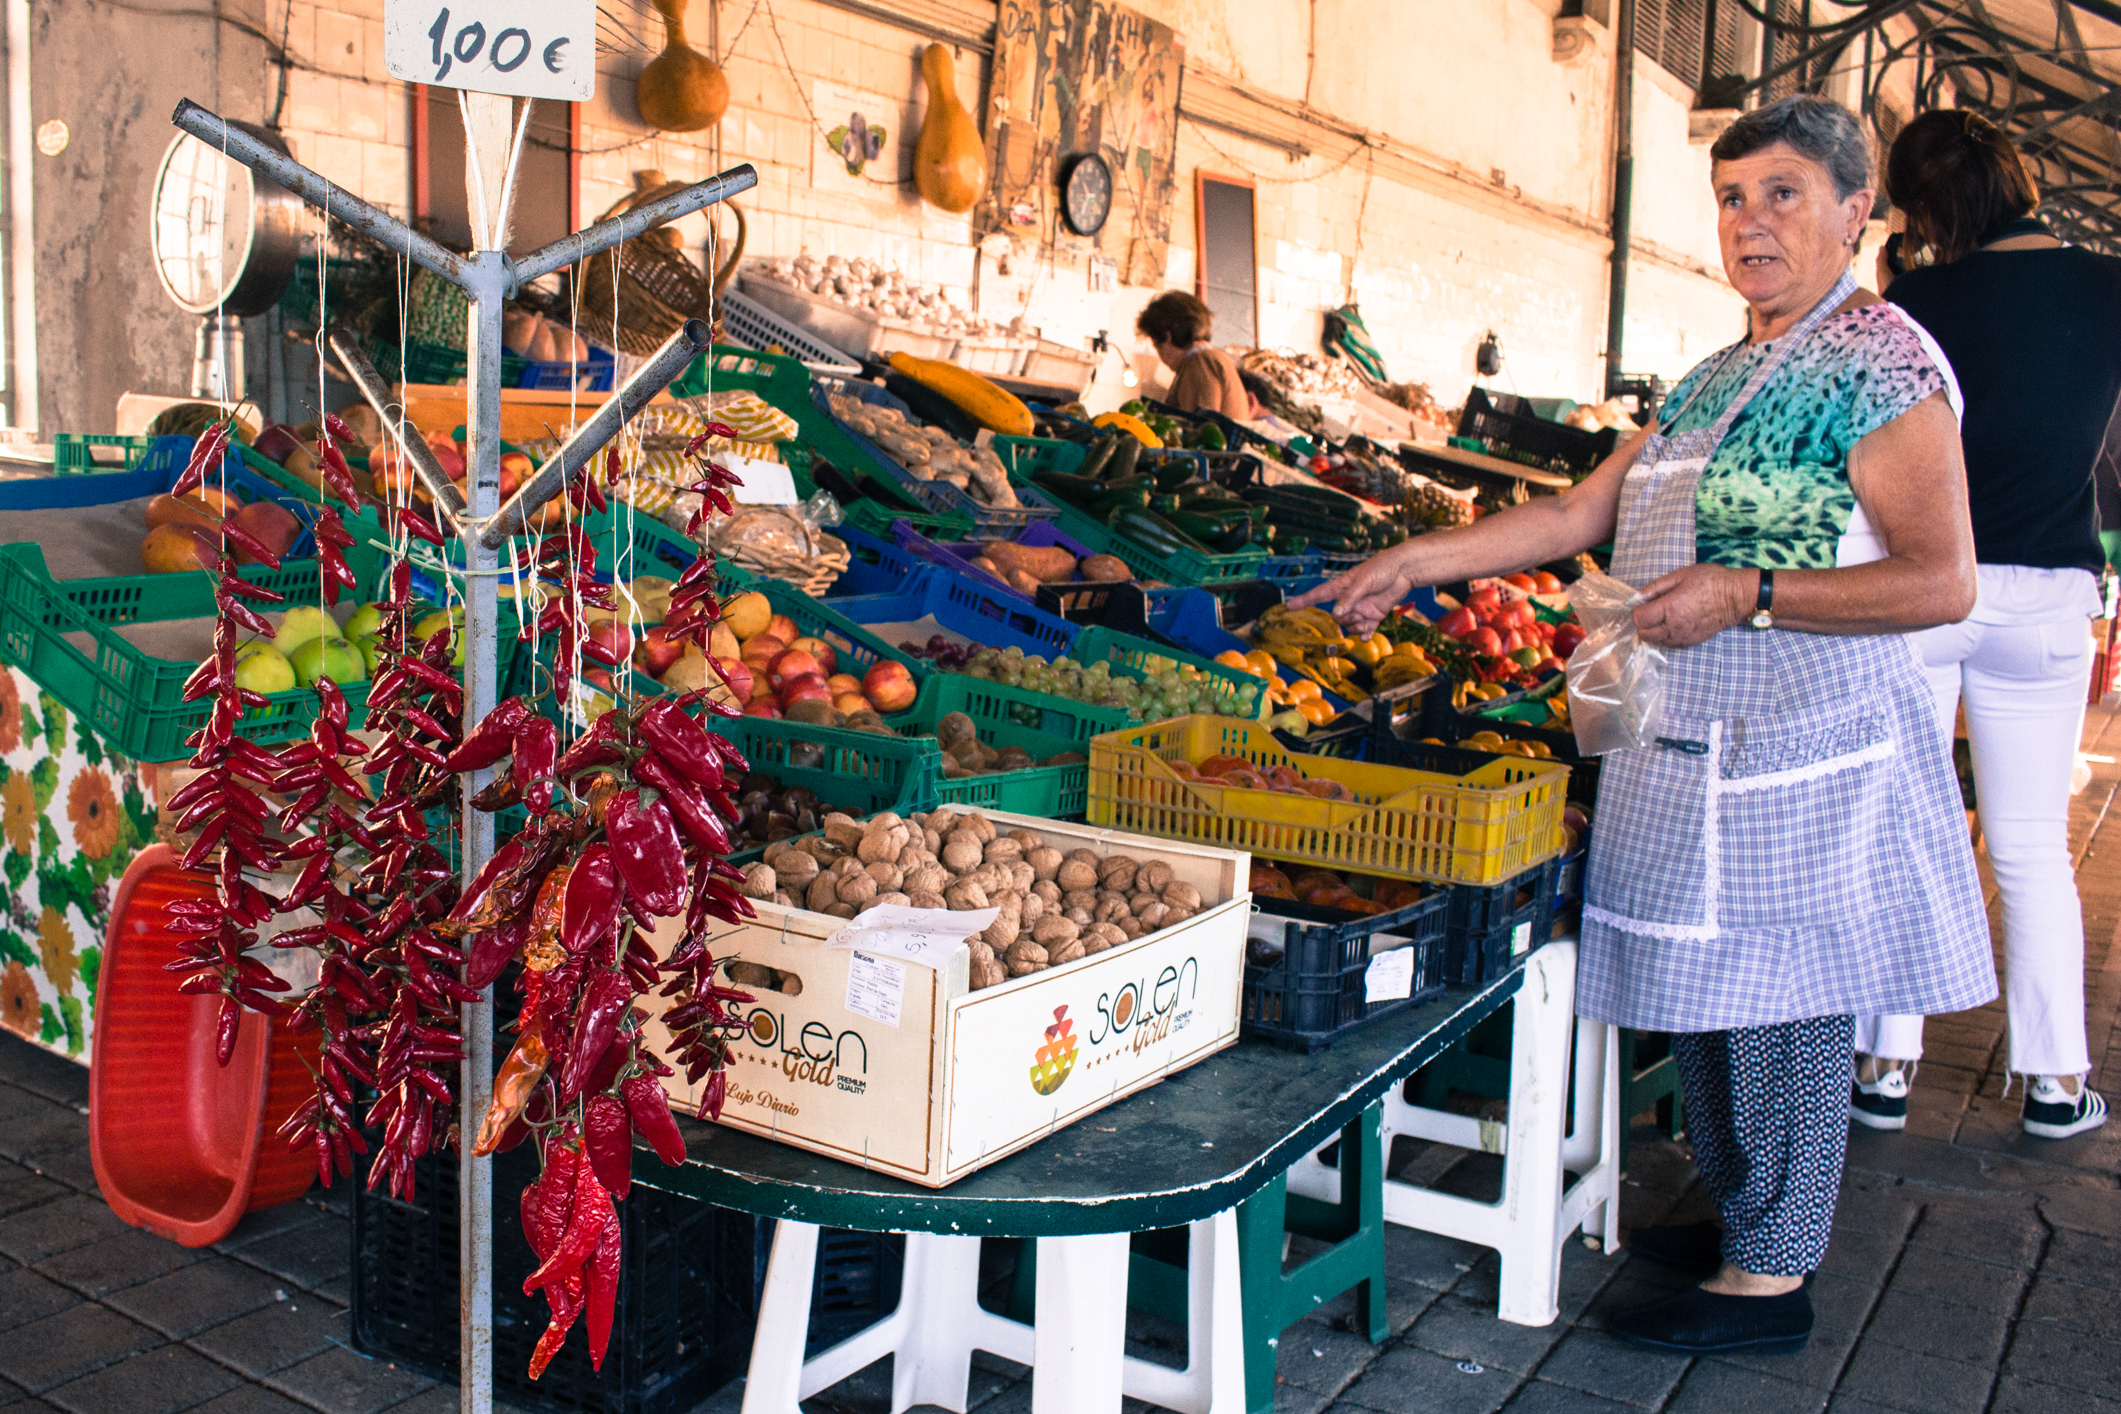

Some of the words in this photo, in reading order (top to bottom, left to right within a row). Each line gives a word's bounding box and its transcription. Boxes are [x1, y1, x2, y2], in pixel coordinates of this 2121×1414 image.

[428, 6, 532, 82] 1,00
[543, 36, 571, 74] €
[1132, 1000, 1176, 1058] Gold
[782, 1047, 836, 1087] Gold
[837, 1074, 867, 1089] PREMIUM
[725, 1081, 754, 1106] Lujo
[756, 1090, 800, 1117] Diario
[837, 1082, 865, 1096] QUALITY
